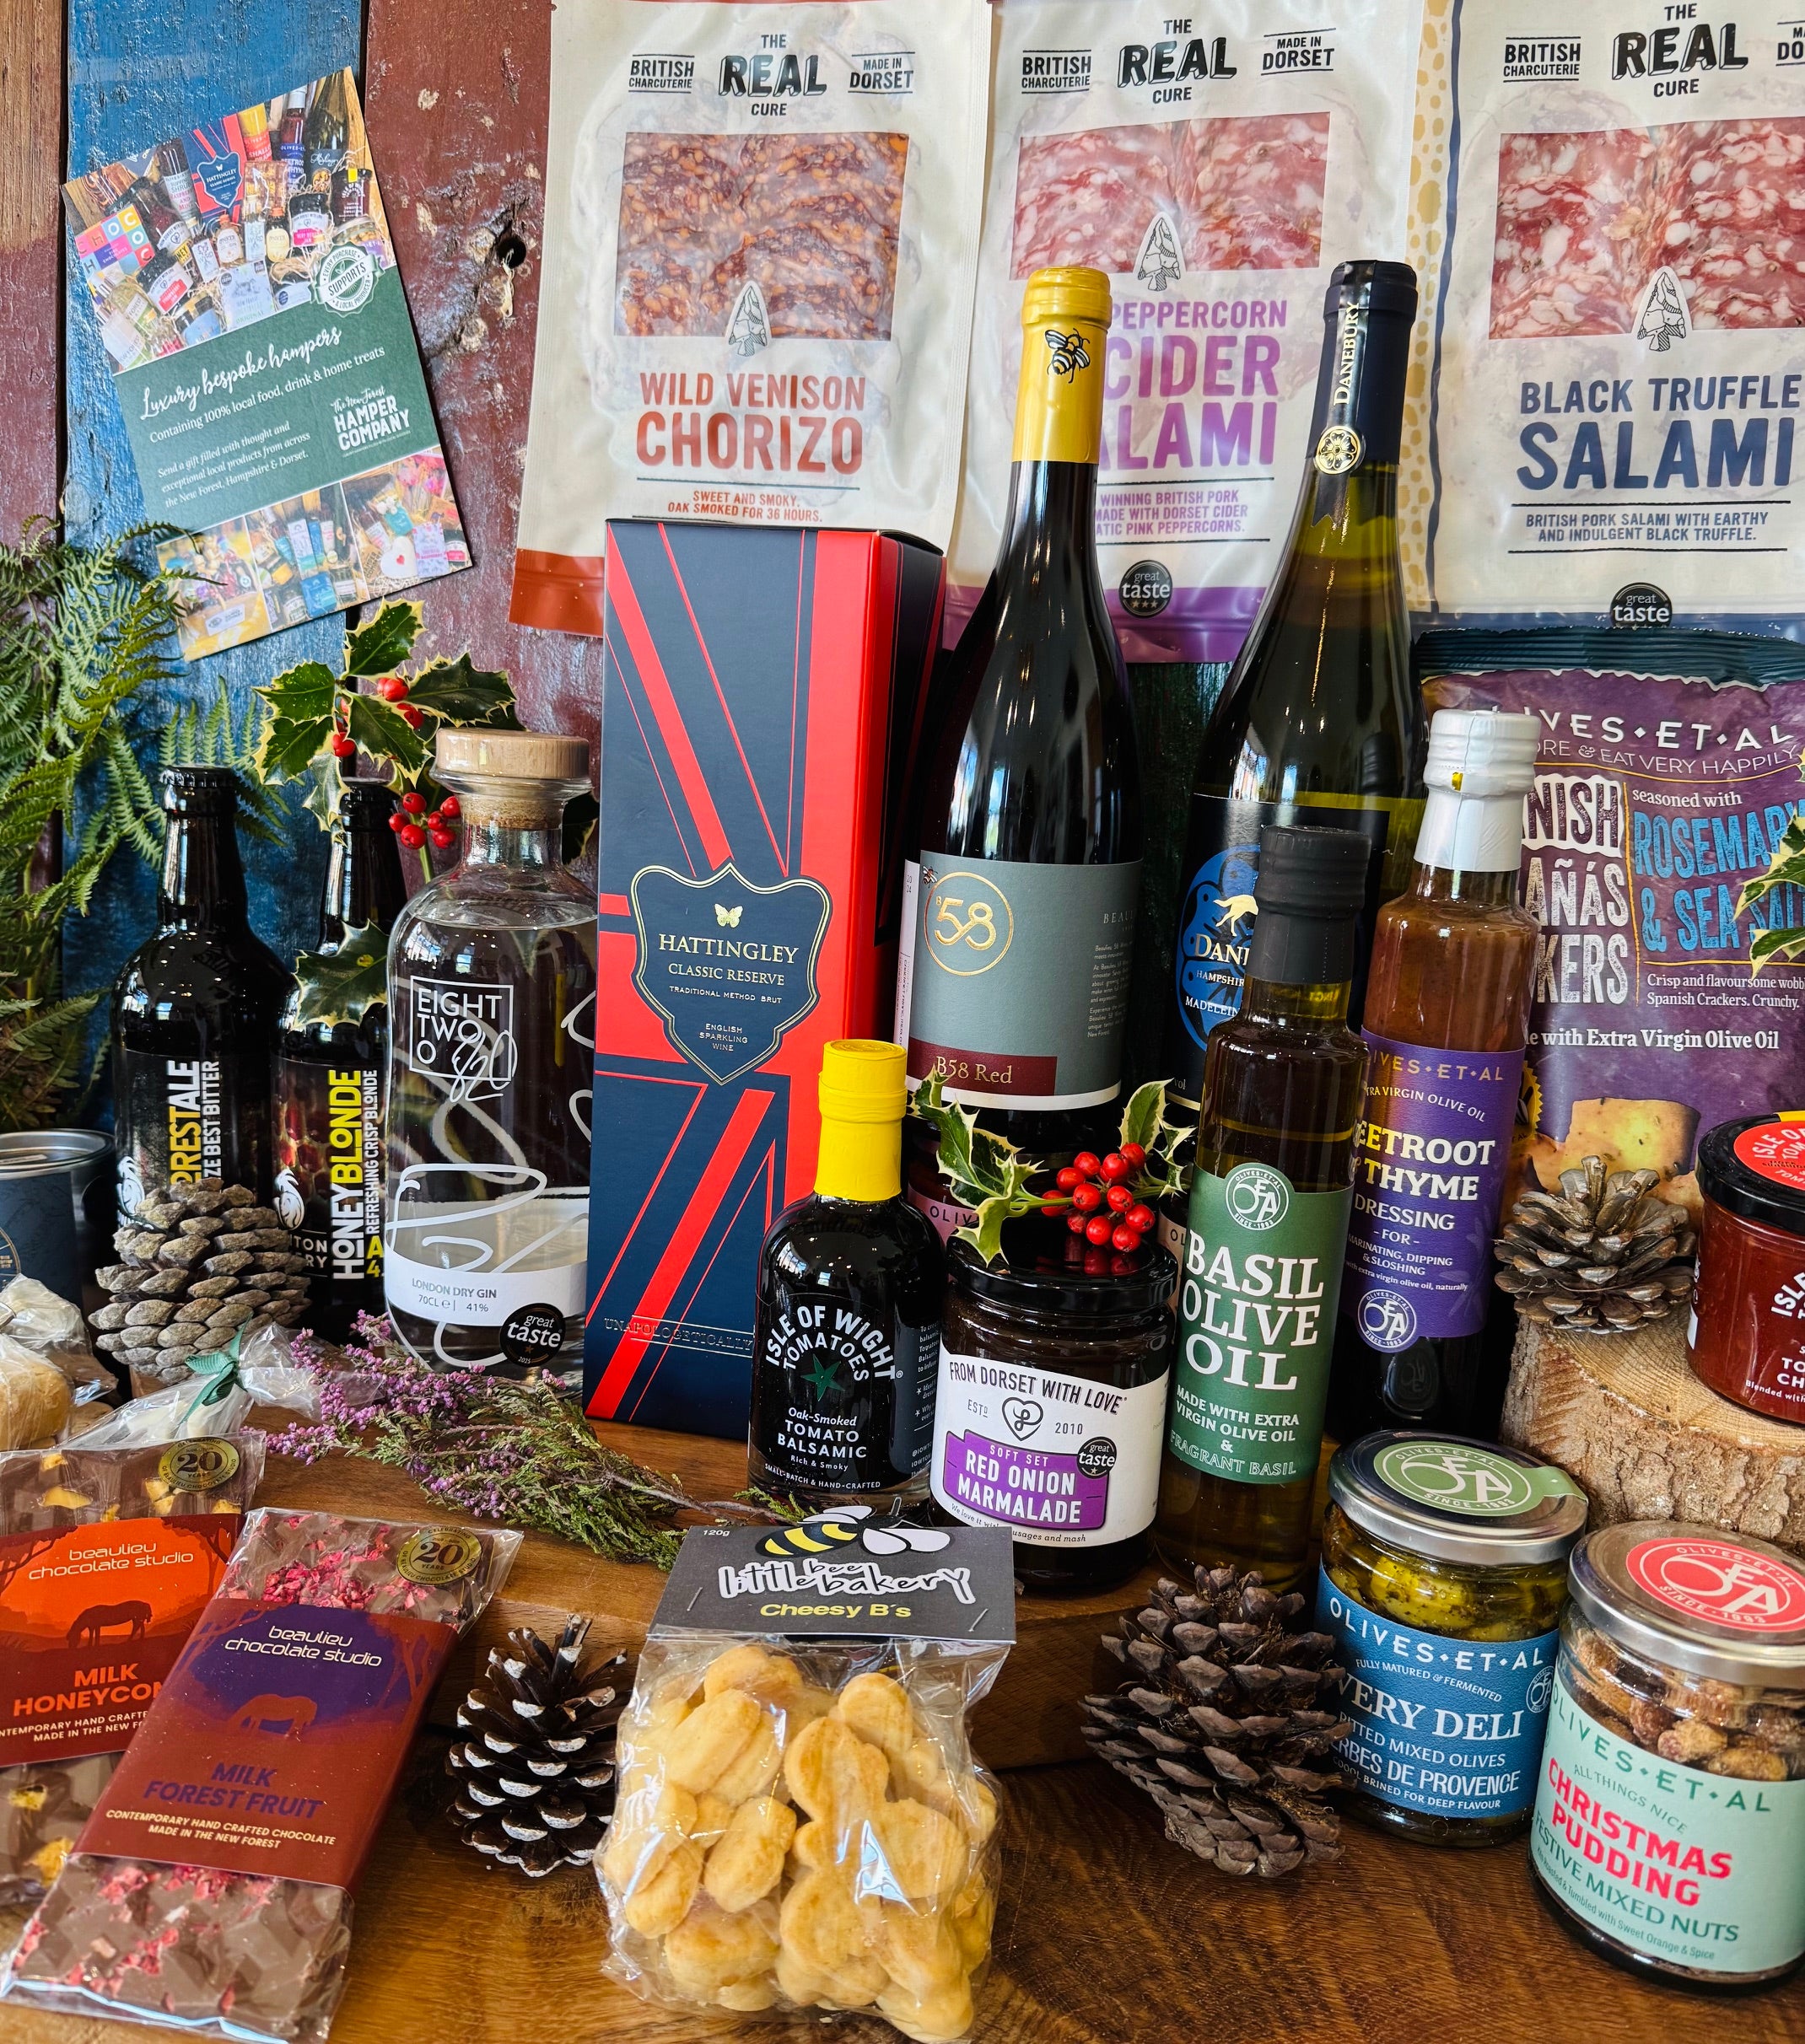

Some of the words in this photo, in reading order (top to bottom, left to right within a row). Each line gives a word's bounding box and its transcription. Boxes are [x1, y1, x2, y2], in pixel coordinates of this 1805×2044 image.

[761, 35, 786, 48] THE
[630, 60, 694, 78] BRITISH
[718, 54, 827, 97] REAL
[849, 69, 913, 90] DORSET
[863, 58, 888, 72] MADE
[891, 57, 902, 70] IN
[628, 76, 692, 89] CHARCUTERIE
[751, 101, 786, 116] CURE
[328, 262, 366, 296] SUPPORTS
[1104, 335, 1280, 398] CIDER
[1333, 301, 1360, 407] DANEBURY
[140, 385, 200, 420] Luxury
[202, 350, 267, 394] bespoke
[268, 327, 342, 368] hampers
[150, 414, 203, 444] Containing
[203, 406, 231, 423] 100%
[233, 397, 256, 413] local
[257, 385, 283, 404] food,
[285, 374, 312, 393] drink
[314, 371, 322, 382] &
[324, 359, 352, 378] home
[354, 346, 385, 366] treats
[640, 372, 713, 406] WILD
[726, 374, 865, 411] VENISON
[1520, 379, 1635, 415] BLACK
[1648, 374, 1801, 411] TRUFFLE
[333, 395, 397, 433] HAMPER
[337, 409, 410, 451] COMPANY
[637, 411, 864, 474] CHORIZO
[158, 465, 177, 478] Send
[185, 455, 199, 473] gift
[201, 449, 220, 464] filled
[222, 441, 240, 455] with
[241, 430, 273, 450] thought
[274, 421, 290, 433] and
[162, 466, 205, 493] exceptional
[207, 460, 226, 475] local
[227, 447, 262, 471] products
[263, 442, 282, 460] from
[283, 433, 310, 447] across
[1517, 416, 1796, 490] SALAMI
[165, 497, 177, 508] the
[178, 491, 196, 503] New
[197, 481, 224, 498] Forest,
[225, 465, 269, 487] Hampshire
[279, 450, 309, 466] Dorset.
[667, 501, 689, 514] OAK
[692, 503, 739, 516] SMOKED
[742, 505, 763, 517] FOR
[767, 508, 779, 519] 36
[783, 508, 822, 522] HOURS.
[692, 490, 726, 503] SWEET
[730, 492, 755, 504] AND
[760, 492, 800, 508] SMOKY.
[1101, 492, 1150, 506] WINNING
[1156, 491, 1203, 505] BRITISH
[1208, 489, 1239, 503] PORK
[1526, 511, 1578, 529] BRITISH
[1582, 511, 1617, 527] PORK
[1621, 510, 1670, 527] SALAMI
[1674, 510, 1710, 525] WITH
[1714, 510, 1769, 525] EARTHY
[1538, 528, 1565, 543] AND
[1568, 528, 1642, 542] INDULGENT
[1646, 527, 1689, 542] BLACK
[1694, 526, 1757, 541] TRUFFLE.
[1612, 603, 1670, 625] taste
[1625, 593, 1657, 608] great
[1639, 755, 1695, 774] VERY
[1703, 744, 1797, 774] HAPPILY
[1633, 788, 1700, 808] seasoned
[1703, 790, 1742, 806] with
[1674, 884, 1739, 952] SEA
[659, 933, 799, 965] HATTINGLEY
[668, 962, 723, 979] CLASSIC
[726, 969, 785, 987] RESERVE
[418, 988, 502, 1020] EIGHT
[669, 985, 721, 998] TRADITIONAL
[723, 991, 756, 1002] METHOD
[761, 995, 783, 1004] BRUT
[1647, 992, 1695, 1007] Spanish
[1697, 992, 1749, 1006] Crackers.
[1752, 993, 1799, 1010] Crunchy.
[418, 1014, 482, 1045] TWO
[698, 1030, 749, 1044] SPARKLING
[705, 1023, 743, 1035] ENGLISH
[1541, 1030, 1582, 1046] with
[1587, 1030, 1636, 1046] Extra
[1641, 1030, 1703, 1051] Virgin
[1705, 1030, 1751, 1047] Olive
[1754, 1031, 1779, 1049] Oil
[712, 1042, 735, 1052] WINE
[935, 1056, 969, 1080] B58
[975, 1064, 1013, 1084] Red
[201, 1061, 220, 1115] BITTER
[364, 1069, 378, 1120] BLONDE
[1382, 1086, 1424, 1101] VIRGIN
[1427, 1094, 1466, 1113] OLIVE
[1468, 1105, 1485, 1122] OIL
[202, 1117, 222, 1156] BEST
[365, 1122, 379, 1158] CRISP
[1365, 1158, 1479, 1201] THYME
[366, 1159, 380, 1234] REFRESHING
[1355, 1194, 1454, 1230] DRESSING
[1382, 1229, 1410, 1245] FOR
[1186, 1228, 1323, 1299] BASIL
[1407, 1253, 1452, 1267] DIPPING
[412, 1278, 450, 1296] LONDON
[453, 1287, 476, 1299] DRY
[478, 1288, 498, 1299] GIN
[1436, 1283, 1468, 1292] naturally
[418, 1294, 439, 1309] 70CL
[466, 1302, 489, 1313] 41%
[1183, 1279, 1321, 1347] OLIVE
[507, 1319, 562, 1350] taste
[523, 1312, 555, 1330] great
[765, 1313, 796, 1366] ISLE
[797, 1305, 826, 1328] OF
[834, 1308, 896, 1380] WIGHT
[783, 1331, 870, 1381] TOMATOES
[1186, 1333, 1297, 1390] OIL
[949, 1361, 977, 1384] FROM
[980, 1367, 1036, 1395] DORSET
[1042, 1379, 1080, 1404] WITH
[1085, 1388, 1121, 1415] LOVE
[788, 1407, 857, 1427] Oak-Smoked
[1177, 1385, 1206, 1411] MADE
[1210, 1401, 1249, 1424] WITH
[1255, 1414, 1299, 1426] EXTRA
[784, 1419, 859, 1443] TOMATO
[1054, 1422, 1083, 1435] 2010
[777, 1433, 867, 1459] BALSAMIC
[990, 1444, 1018, 1461] SOFT
[1026, 1453, 1048, 1467] SET
[1078, 1451, 1115, 1468] taste
[1089, 1443, 1110, 1453] great
[1170, 1429, 1245, 1474] FRAGRANT
[1249, 1460, 1296, 1477] BASIL
[764, 1462, 808, 1485] SMALL-BATCH
[818, 1481, 881, 1489] HAND-CRAFTED
[790, 1455, 808, 1466] Rich
[820, 1460, 849, 1471] Smoky
[965, 1449, 999, 1482] RED
[1008, 1465, 1075, 1495] ONION
[957, 1472, 1082, 1523] MARMALADE
[703, 1529, 730, 1537] 120g
[28, 1556, 130, 1581] chocolate
[133, 1551, 194, 1568] studio
[68, 1541, 158, 1562] beaulieu
[412, 1541, 464, 1566] 20
[760, 1604, 863, 1620] Cheesy
[74, 1663, 138, 1689] MILK
[1355, 1657, 1381, 1673] FULLY
[1382, 1660, 1430, 1680] MATURED
[1444, 1676, 1502, 1702] FERMENTED
[1432, 1708, 1524, 1741] DELI
[1388, 1738, 1445, 1763] MIXED
[1448, 1752, 1506, 1767] OLIVES
[211, 1762, 277, 1788] MILK
[1387, 1761, 1414, 1786] DE
[1419, 1769, 1521, 1798] PROVENCE
[143, 1781, 249, 1811] FOREST
[246, 1794, 325, 1820] FRUIT
[1363, 1773, 1401, 1796] BRINED
[1404, 1788, 1426, 1804] FOR
[1429, 1795, 1456, 1808] DEEP
[1457, 1798, 1501, 1810] FLAVOUR
[105, 1809, 191, 1826] CONTEMPORARY
[192, 1817, 220, 1831] HAND
[223, 1821, 269, 1836] CRAFTED
[271, 1826, 337, 1845] CHOCOLATE
[1548, 1757, 1732, 1881] CHRISTMAS
[148, 1824, 176, 1836] MADE
[178, 1828, 188, 1837] IN
[190, 1830, 213, 1840] THE
[215, 1832, 241, 1843] NEW
[243, 1834, 281, 1849] FOREST
[1550, 1802, 1701, 1908] PUDDING
[1535, 1809, 1581, 1883] FESTIVE
[1585, 1872, 1665, 1924] MIXED
[1671, 1914, 1738, 1942] NUTS
